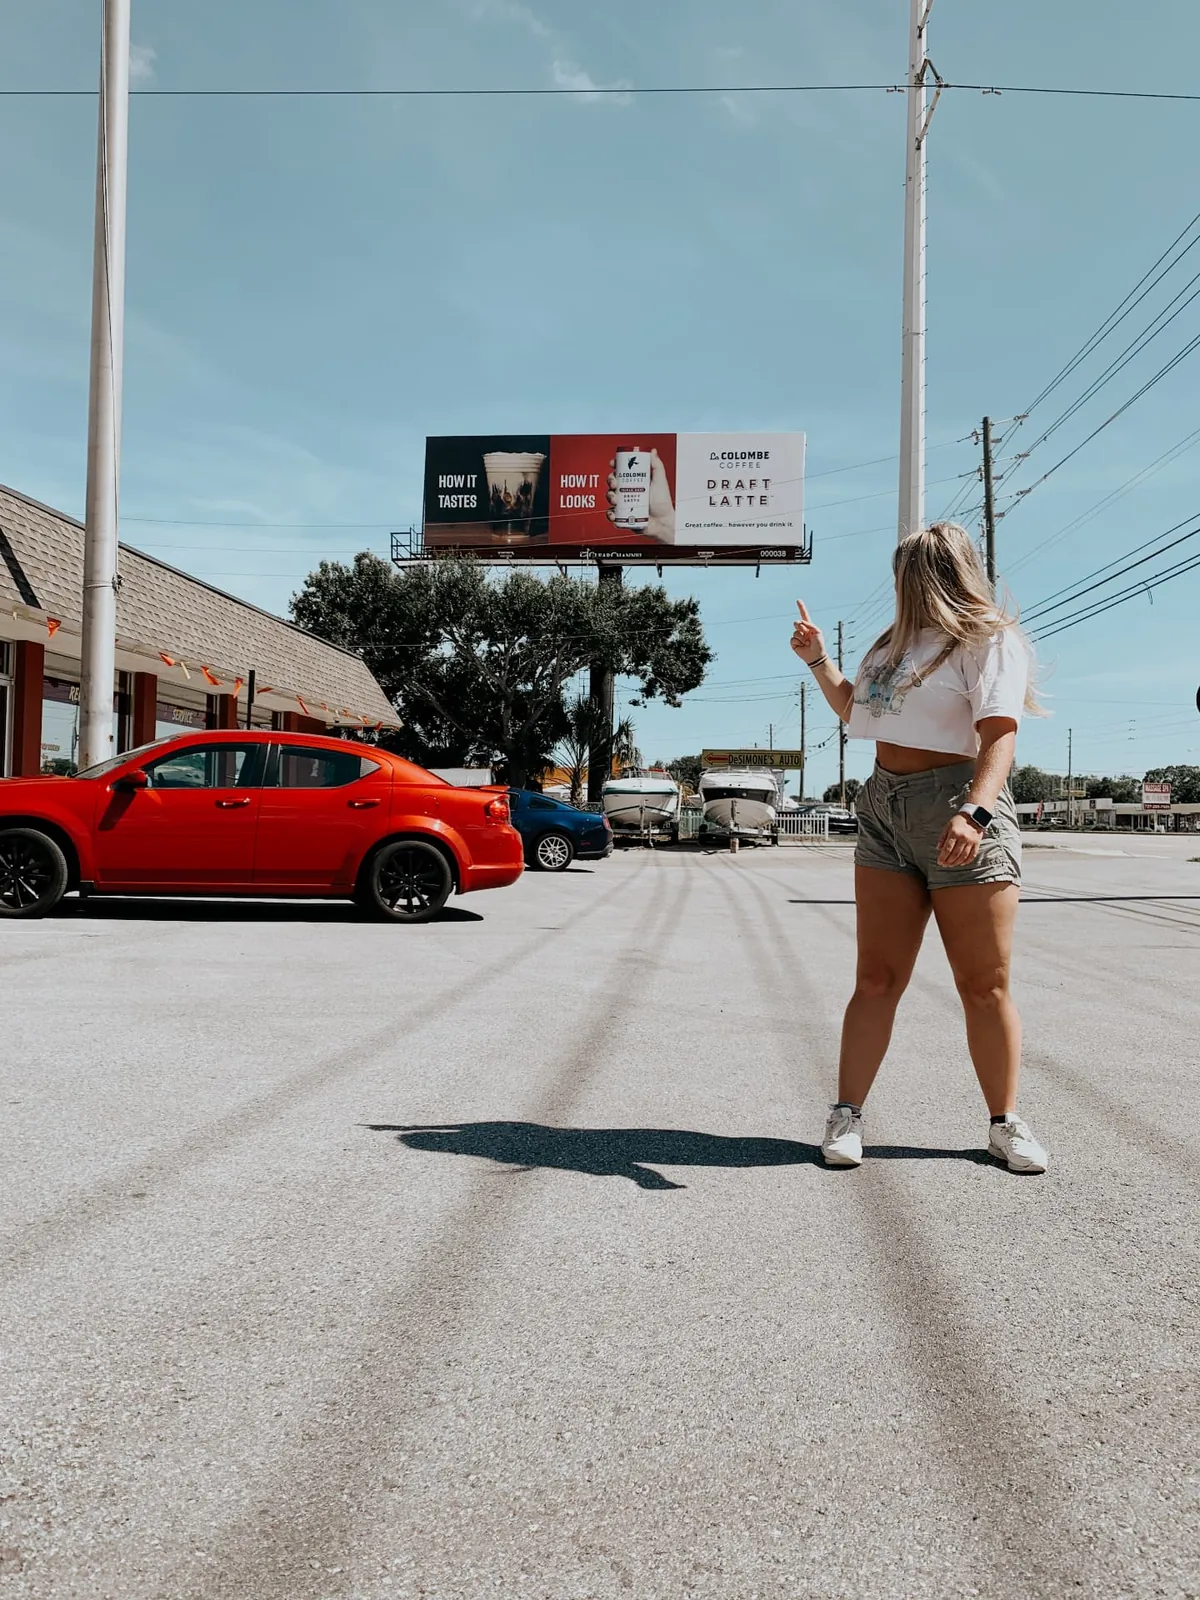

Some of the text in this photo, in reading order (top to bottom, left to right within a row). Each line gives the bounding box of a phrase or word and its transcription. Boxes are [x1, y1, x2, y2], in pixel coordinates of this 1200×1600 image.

[709, 451, 770, 460] La COLOMBE
[719, 461, 761, 469] COFFEE
[438, 474, 477, 488] HOW IT
[560, 474, 599, 488] HOW IT
[707, 479, 771, 490] DRAFT
[438, 494, 477, 508] TASTES
[560, 494, 595, 508] LOOKS
[709, 495, 768, 506] LATTE
[760, 550, 787, 558] 000038
[69, 686, 80, 701] RE
[172, 708, 193, 724] SERVICE
[728, 754, 800, 766] DeSIMONE'S AUTO
